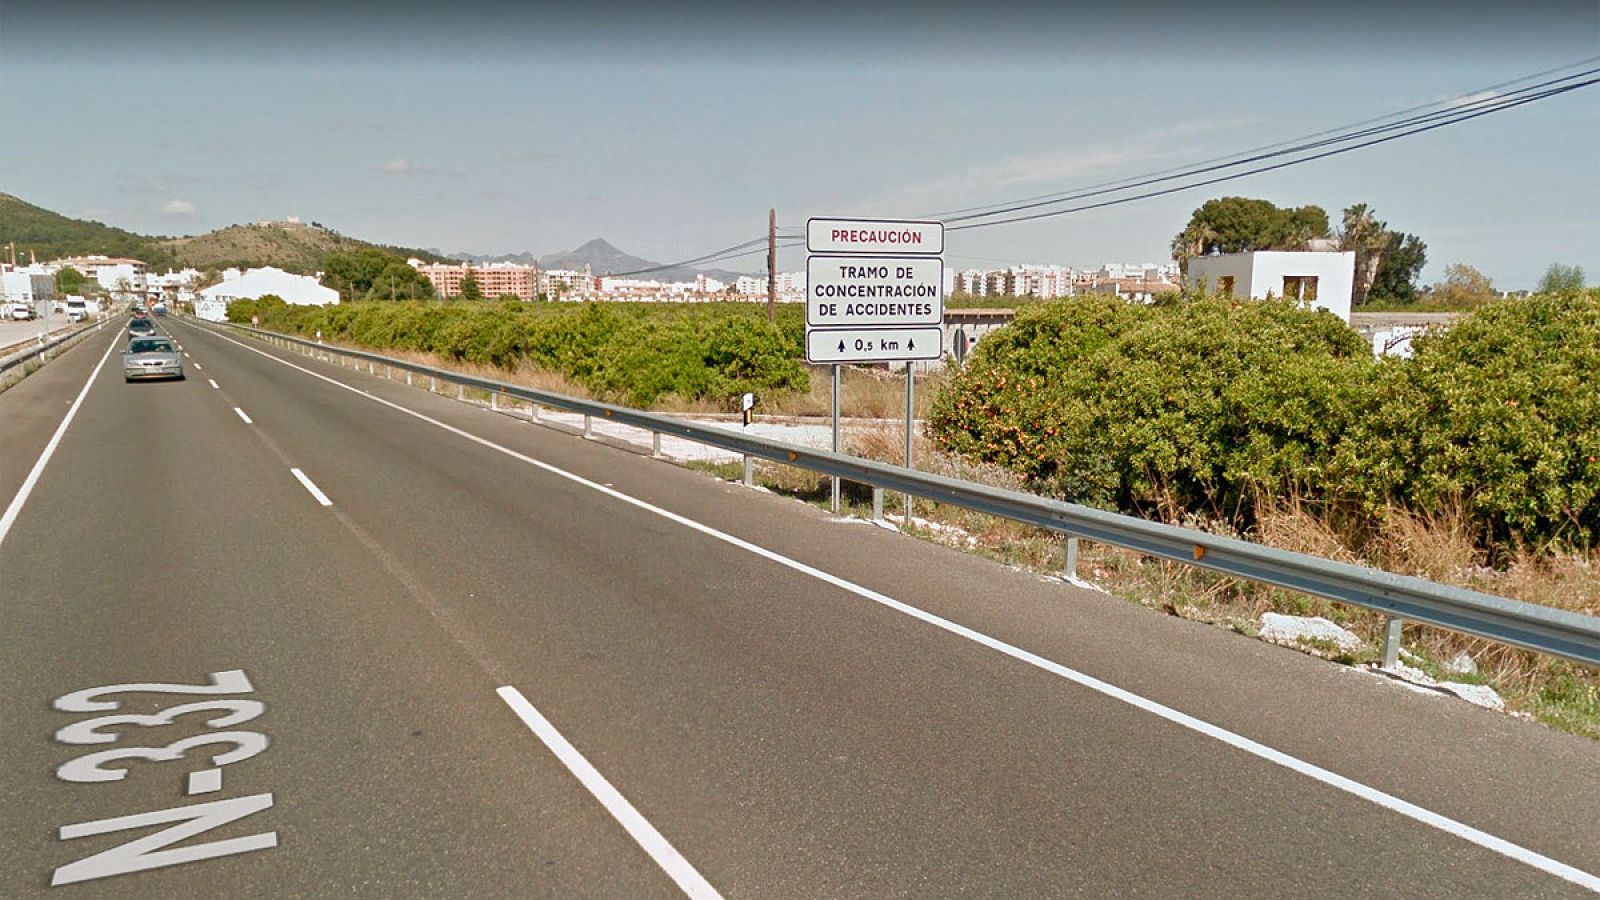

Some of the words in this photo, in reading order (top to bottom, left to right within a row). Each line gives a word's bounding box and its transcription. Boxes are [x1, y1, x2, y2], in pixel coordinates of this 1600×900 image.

[831, 228, 922, 244] PRECAUCIÓN
[840, 266, 888, 279] TRAMO
[896, 267, 913, 279] DE
[815, 282, 937, 297] CONCENTRACIÓN
[819, 304, 837, 316] DE
[846, 303, 932, 316] ACCIDENTES
[880, 338, 899, 351] km
